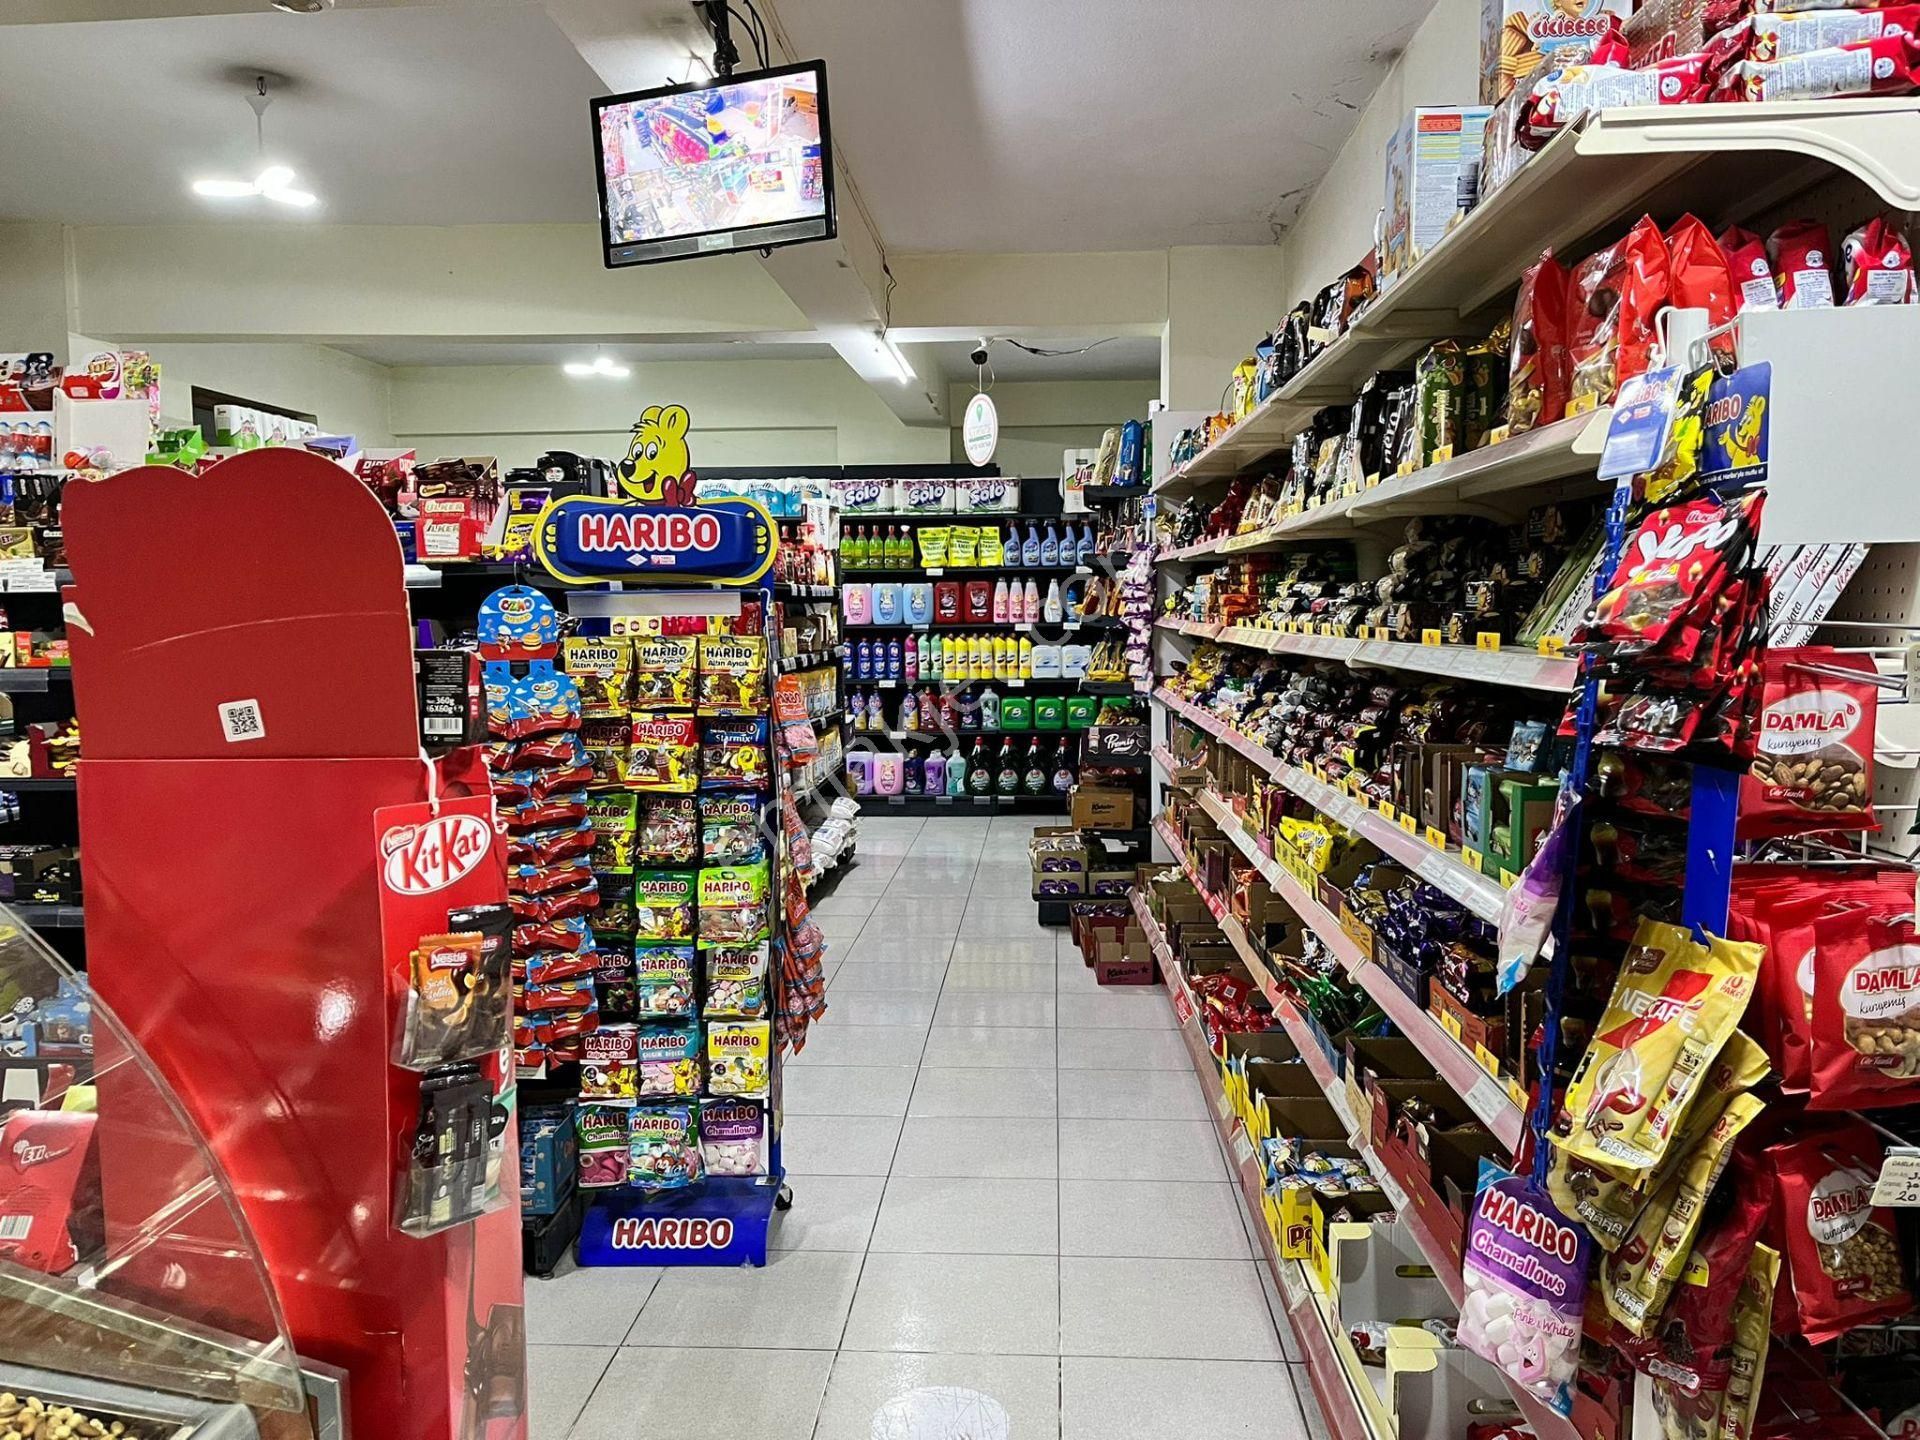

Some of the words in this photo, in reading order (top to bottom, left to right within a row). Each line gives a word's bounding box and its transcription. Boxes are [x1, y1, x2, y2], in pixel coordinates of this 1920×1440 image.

[1704, 394, 1742, 429] ARIBO
[580, 516, 719, 550] HARIBO
[570, 649, 618, 661] HARIBO
[643, 646, 687, 658] HARIBO
[706, 647, 751, 659] HARIBO
[1765, 711, 1847, 732] DAMLA
[638, 724, 685, 736] HARIBO
[715, 734, 751, 744] Starmix
[1767, 736, 1824, 753] kuruyemiş
[647, 799, 693, 810] HARIBO
[704, 804, 750, 815] HARIBO
[402, 819, 482, 890] KitKat
[641, 882, 687, 893] HARIBO
[704, 881, 751, 893] HARIBO
[641, 958, 686, 970] HARIBO
[713, 954, 759, 965] HARIBO
[1859, 996, 1906, 1016] kuruyemiş
[585, 1037, 632, 1050] HARIBO
[641, 1036, 687, 1049] HARIBO
[713, 1035, 760, 1047] HARIBO
[703, 1106, 758, 1122] HARIBO
[583, 1113, 627, 1130] HARIB
[633, 1118, 680, 1131] HARIBO
[705, 1125, 757, 1137] Chamallows
[1814, 1187, 1870, 1221] DAMLA
[1480, 1188, 1578, 1264] HARIBO
[613, 1219, 733, 1249] HARIBO
[1472, 1228, 1566, 1297] Chamallows
[1513, 1308, 1536, 1328] Pink
[1542, 1321, 1576, 1340] White
